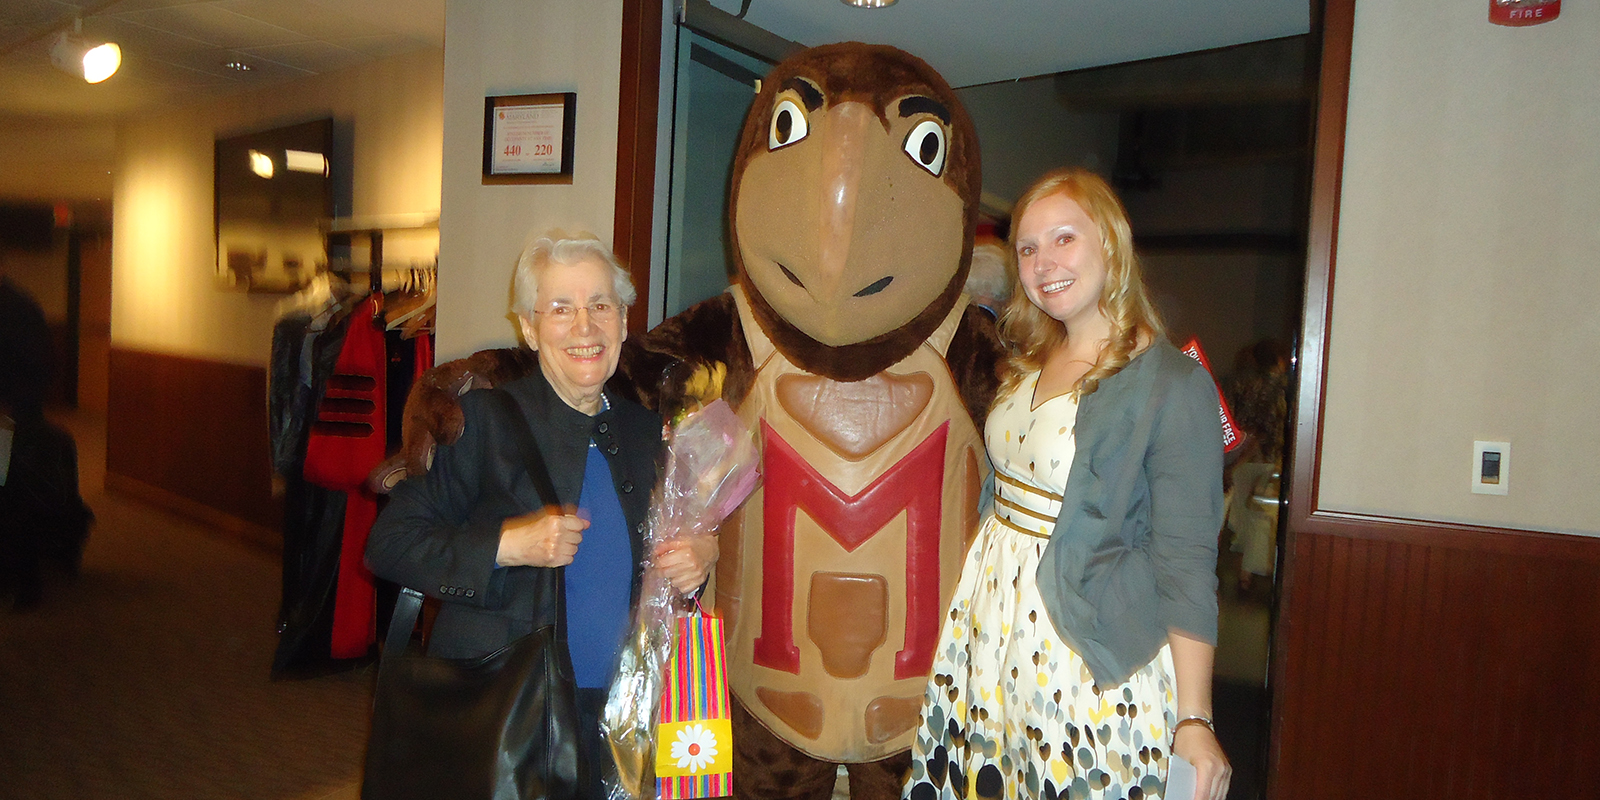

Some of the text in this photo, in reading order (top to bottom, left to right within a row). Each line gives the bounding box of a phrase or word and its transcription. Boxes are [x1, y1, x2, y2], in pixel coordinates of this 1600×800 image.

[1509, 8, 1543, 18] FIRE
[503, 144, 553, 156] 440 220
[1222, 422, 1236, 444] FACE
[753, 417, 950, 680] M
